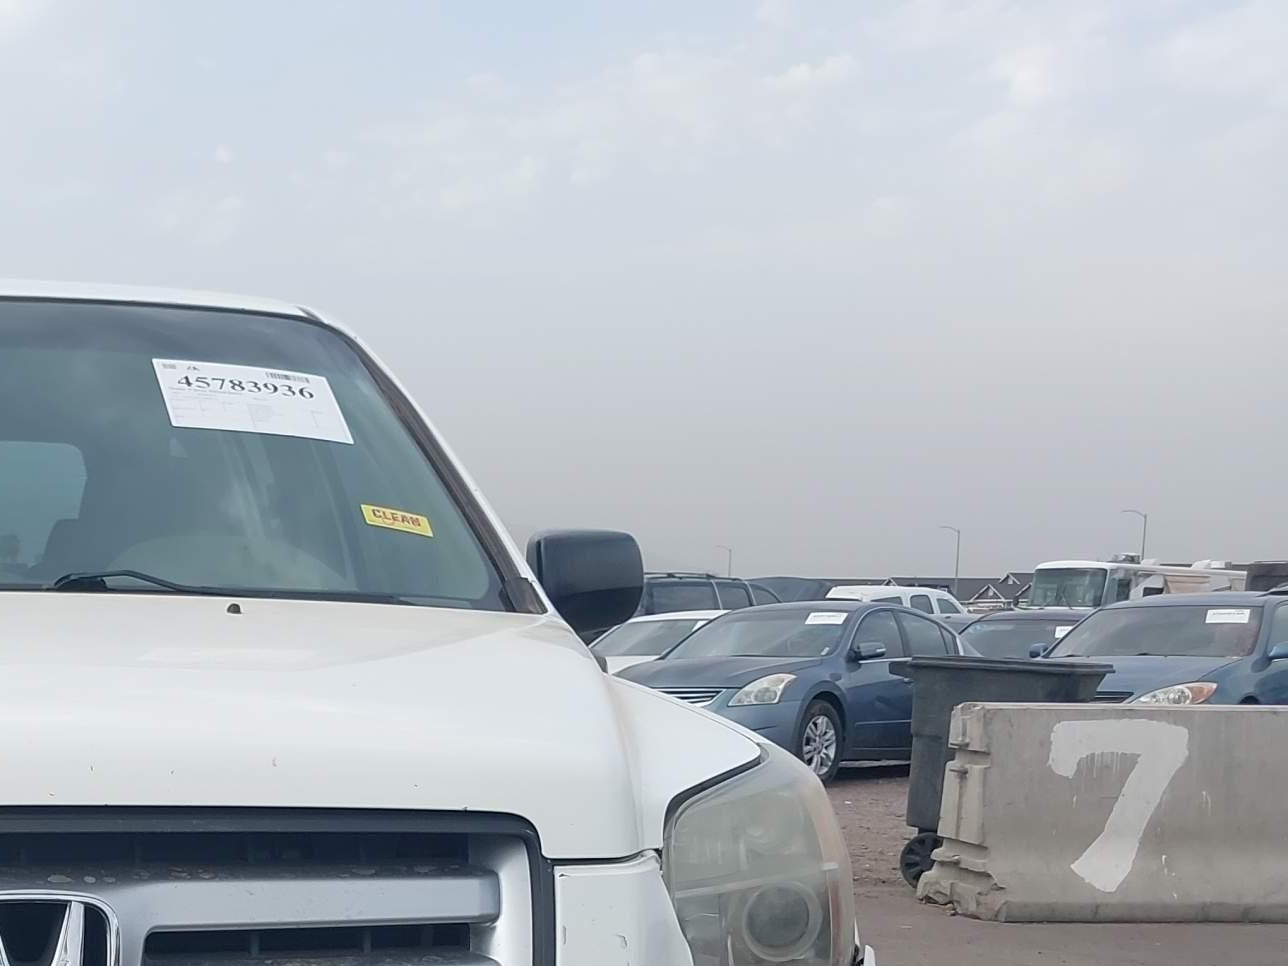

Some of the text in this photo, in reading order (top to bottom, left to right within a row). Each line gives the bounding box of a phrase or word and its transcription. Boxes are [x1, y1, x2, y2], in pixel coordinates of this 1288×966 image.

[177, 375, 315, 399] 45783936
[372, 509, 421, 527] CLEAN
[1047, 718, 1189, 893] 7
